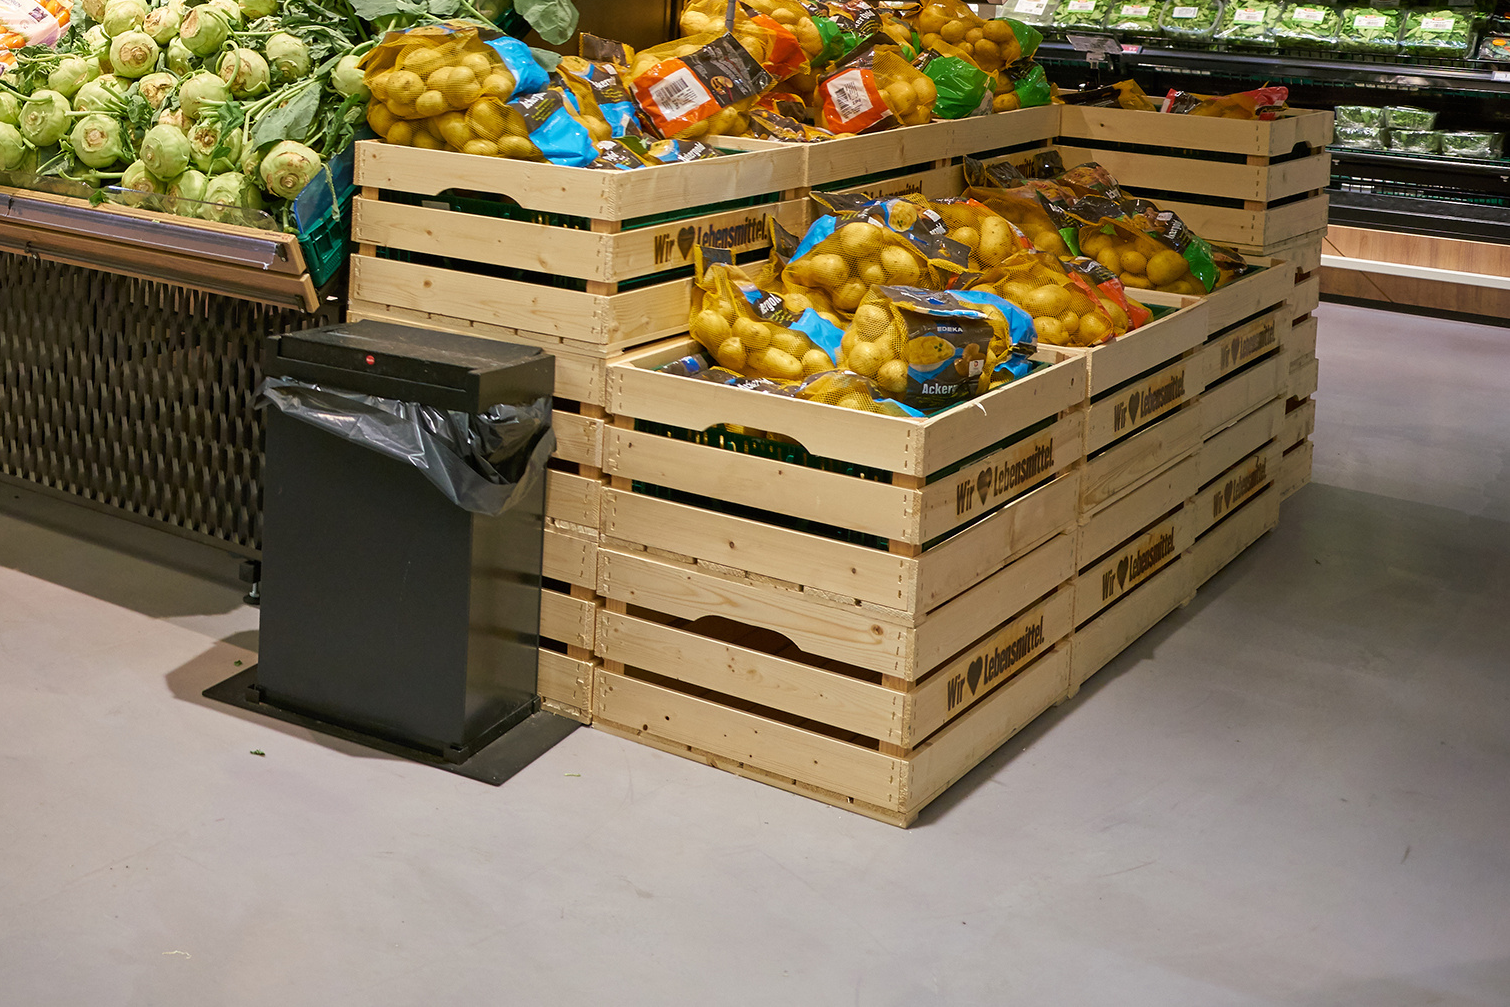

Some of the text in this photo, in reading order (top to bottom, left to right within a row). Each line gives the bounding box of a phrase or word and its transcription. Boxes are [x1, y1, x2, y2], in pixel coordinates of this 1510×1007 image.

[654, 234, 675, 265] Wir
[922, 382, 957, 396] Acker
[1113, 370, 1186, 433] Wir Lebensmittel.
[956, 437, 1054, 516] Wir Lebensmittel.
[1102, 526, 1175, 602] Wir Lebensmittel.
[947, 615, 1045, 712] Wir Lebensmittel.
